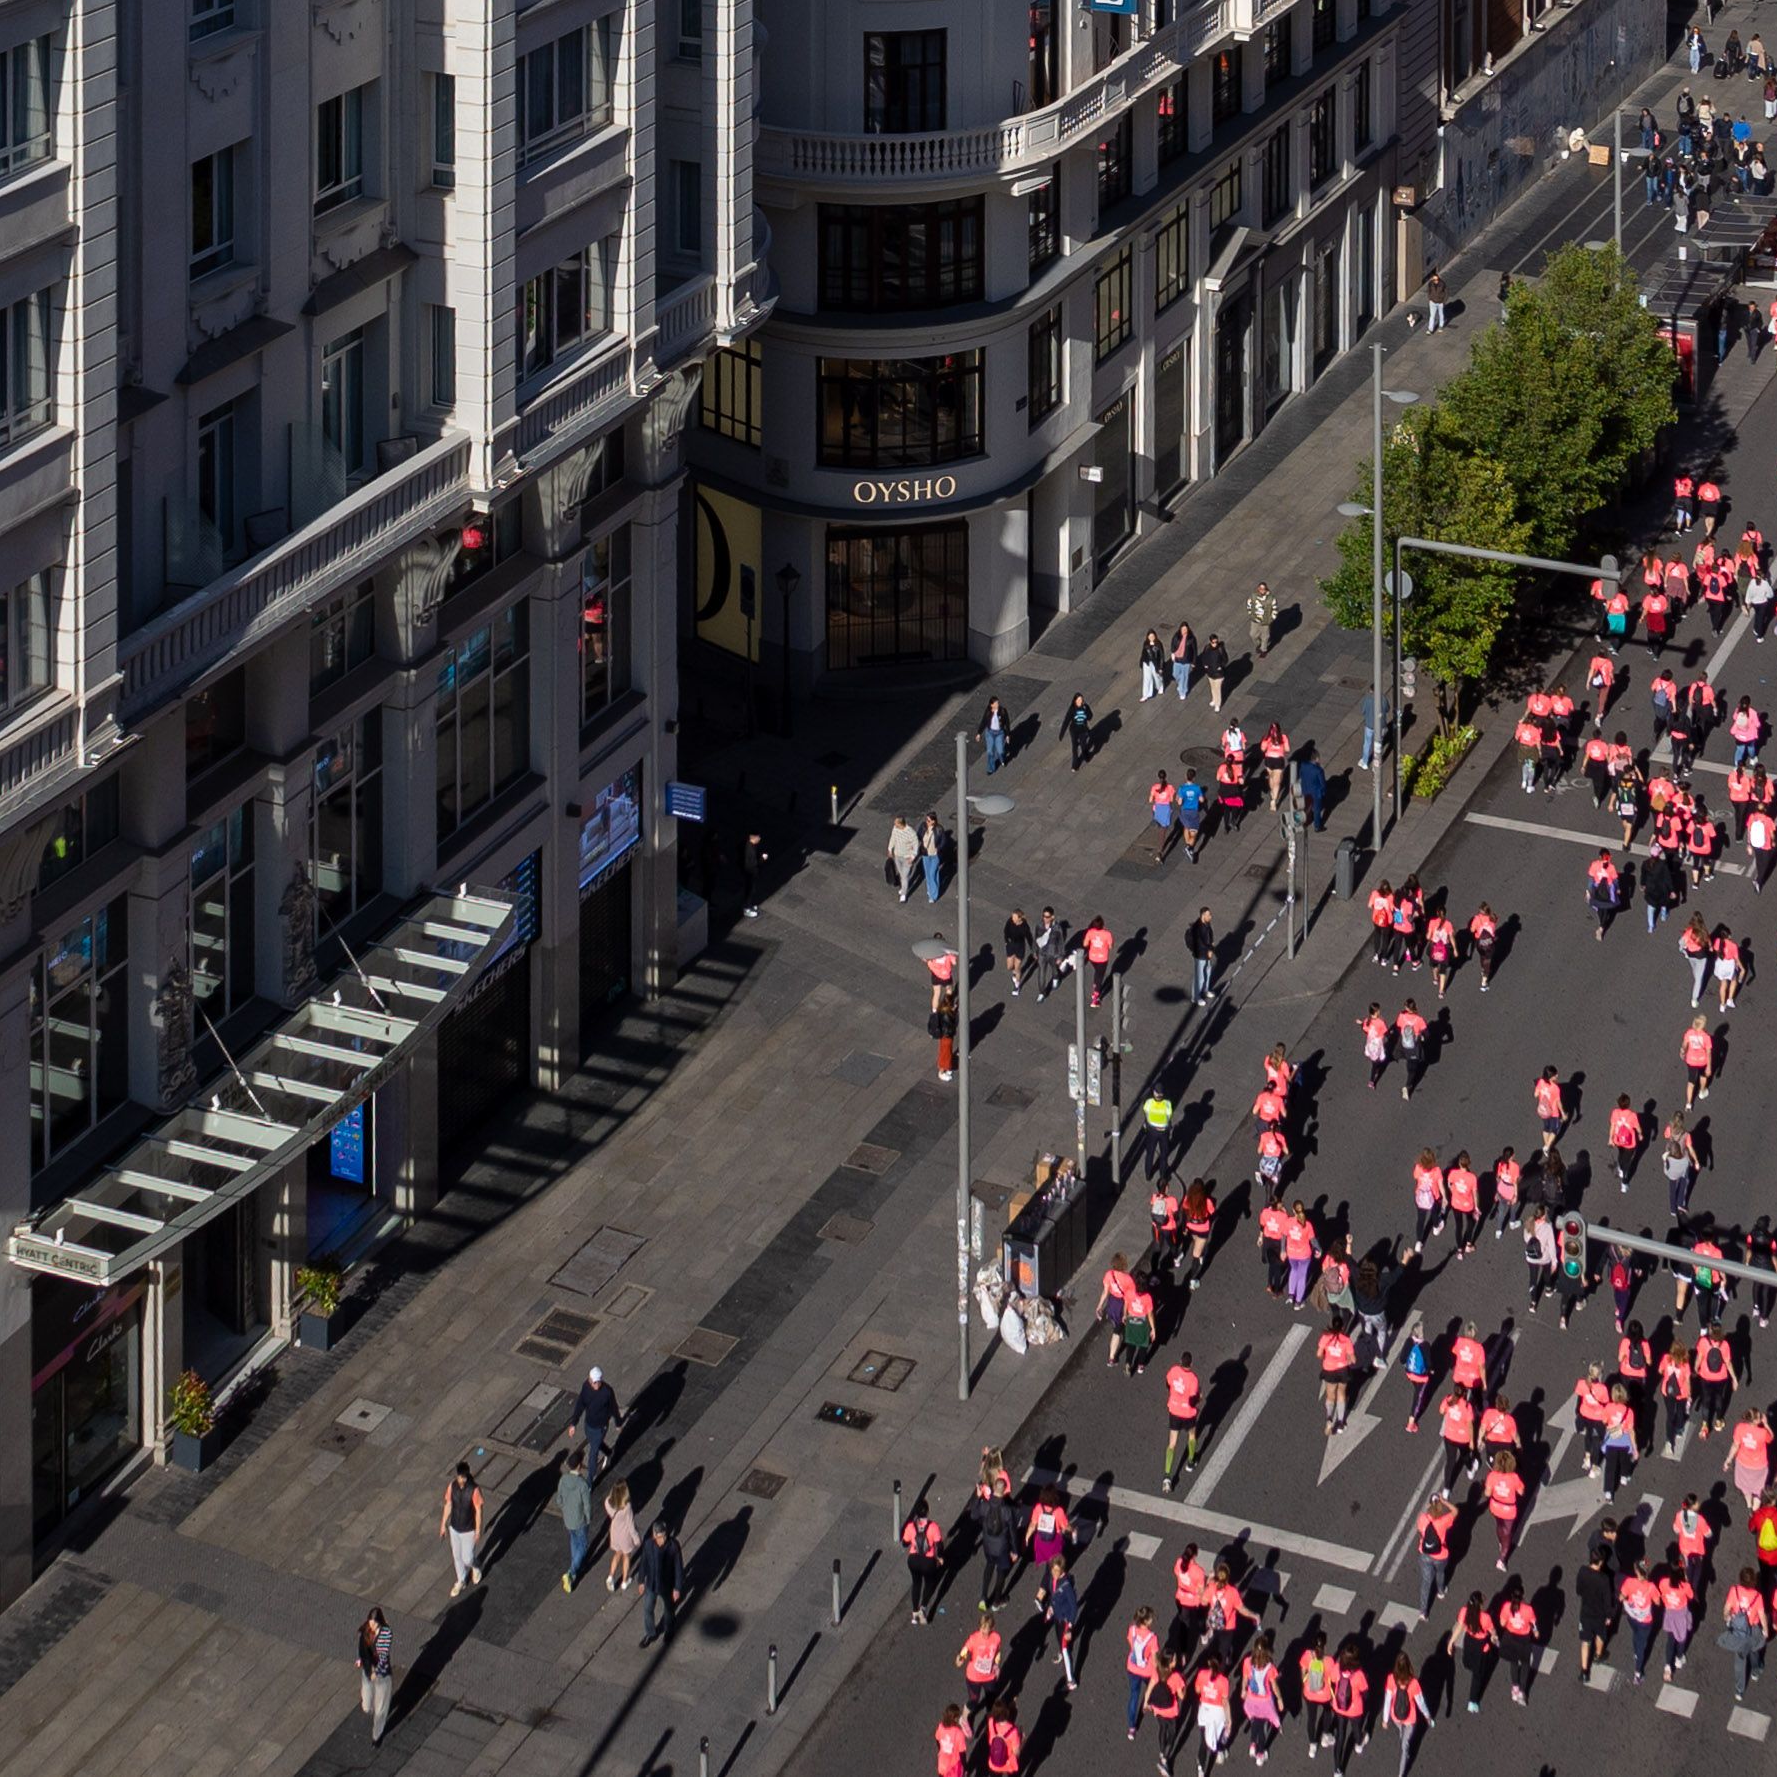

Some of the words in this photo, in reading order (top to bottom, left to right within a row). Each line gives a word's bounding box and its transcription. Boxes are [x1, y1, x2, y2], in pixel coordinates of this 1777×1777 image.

[853, 475, 957, 504] OYSHO
[579, 840, 643, 902] SKECHERS
[453, 946, 527, 1017] SKECHERS
[16, 1244, 50, 1261] HYATT
[51, 1255, 99, 1275] CENTRIC
[86, 1323, 123, 1362] Clarks
